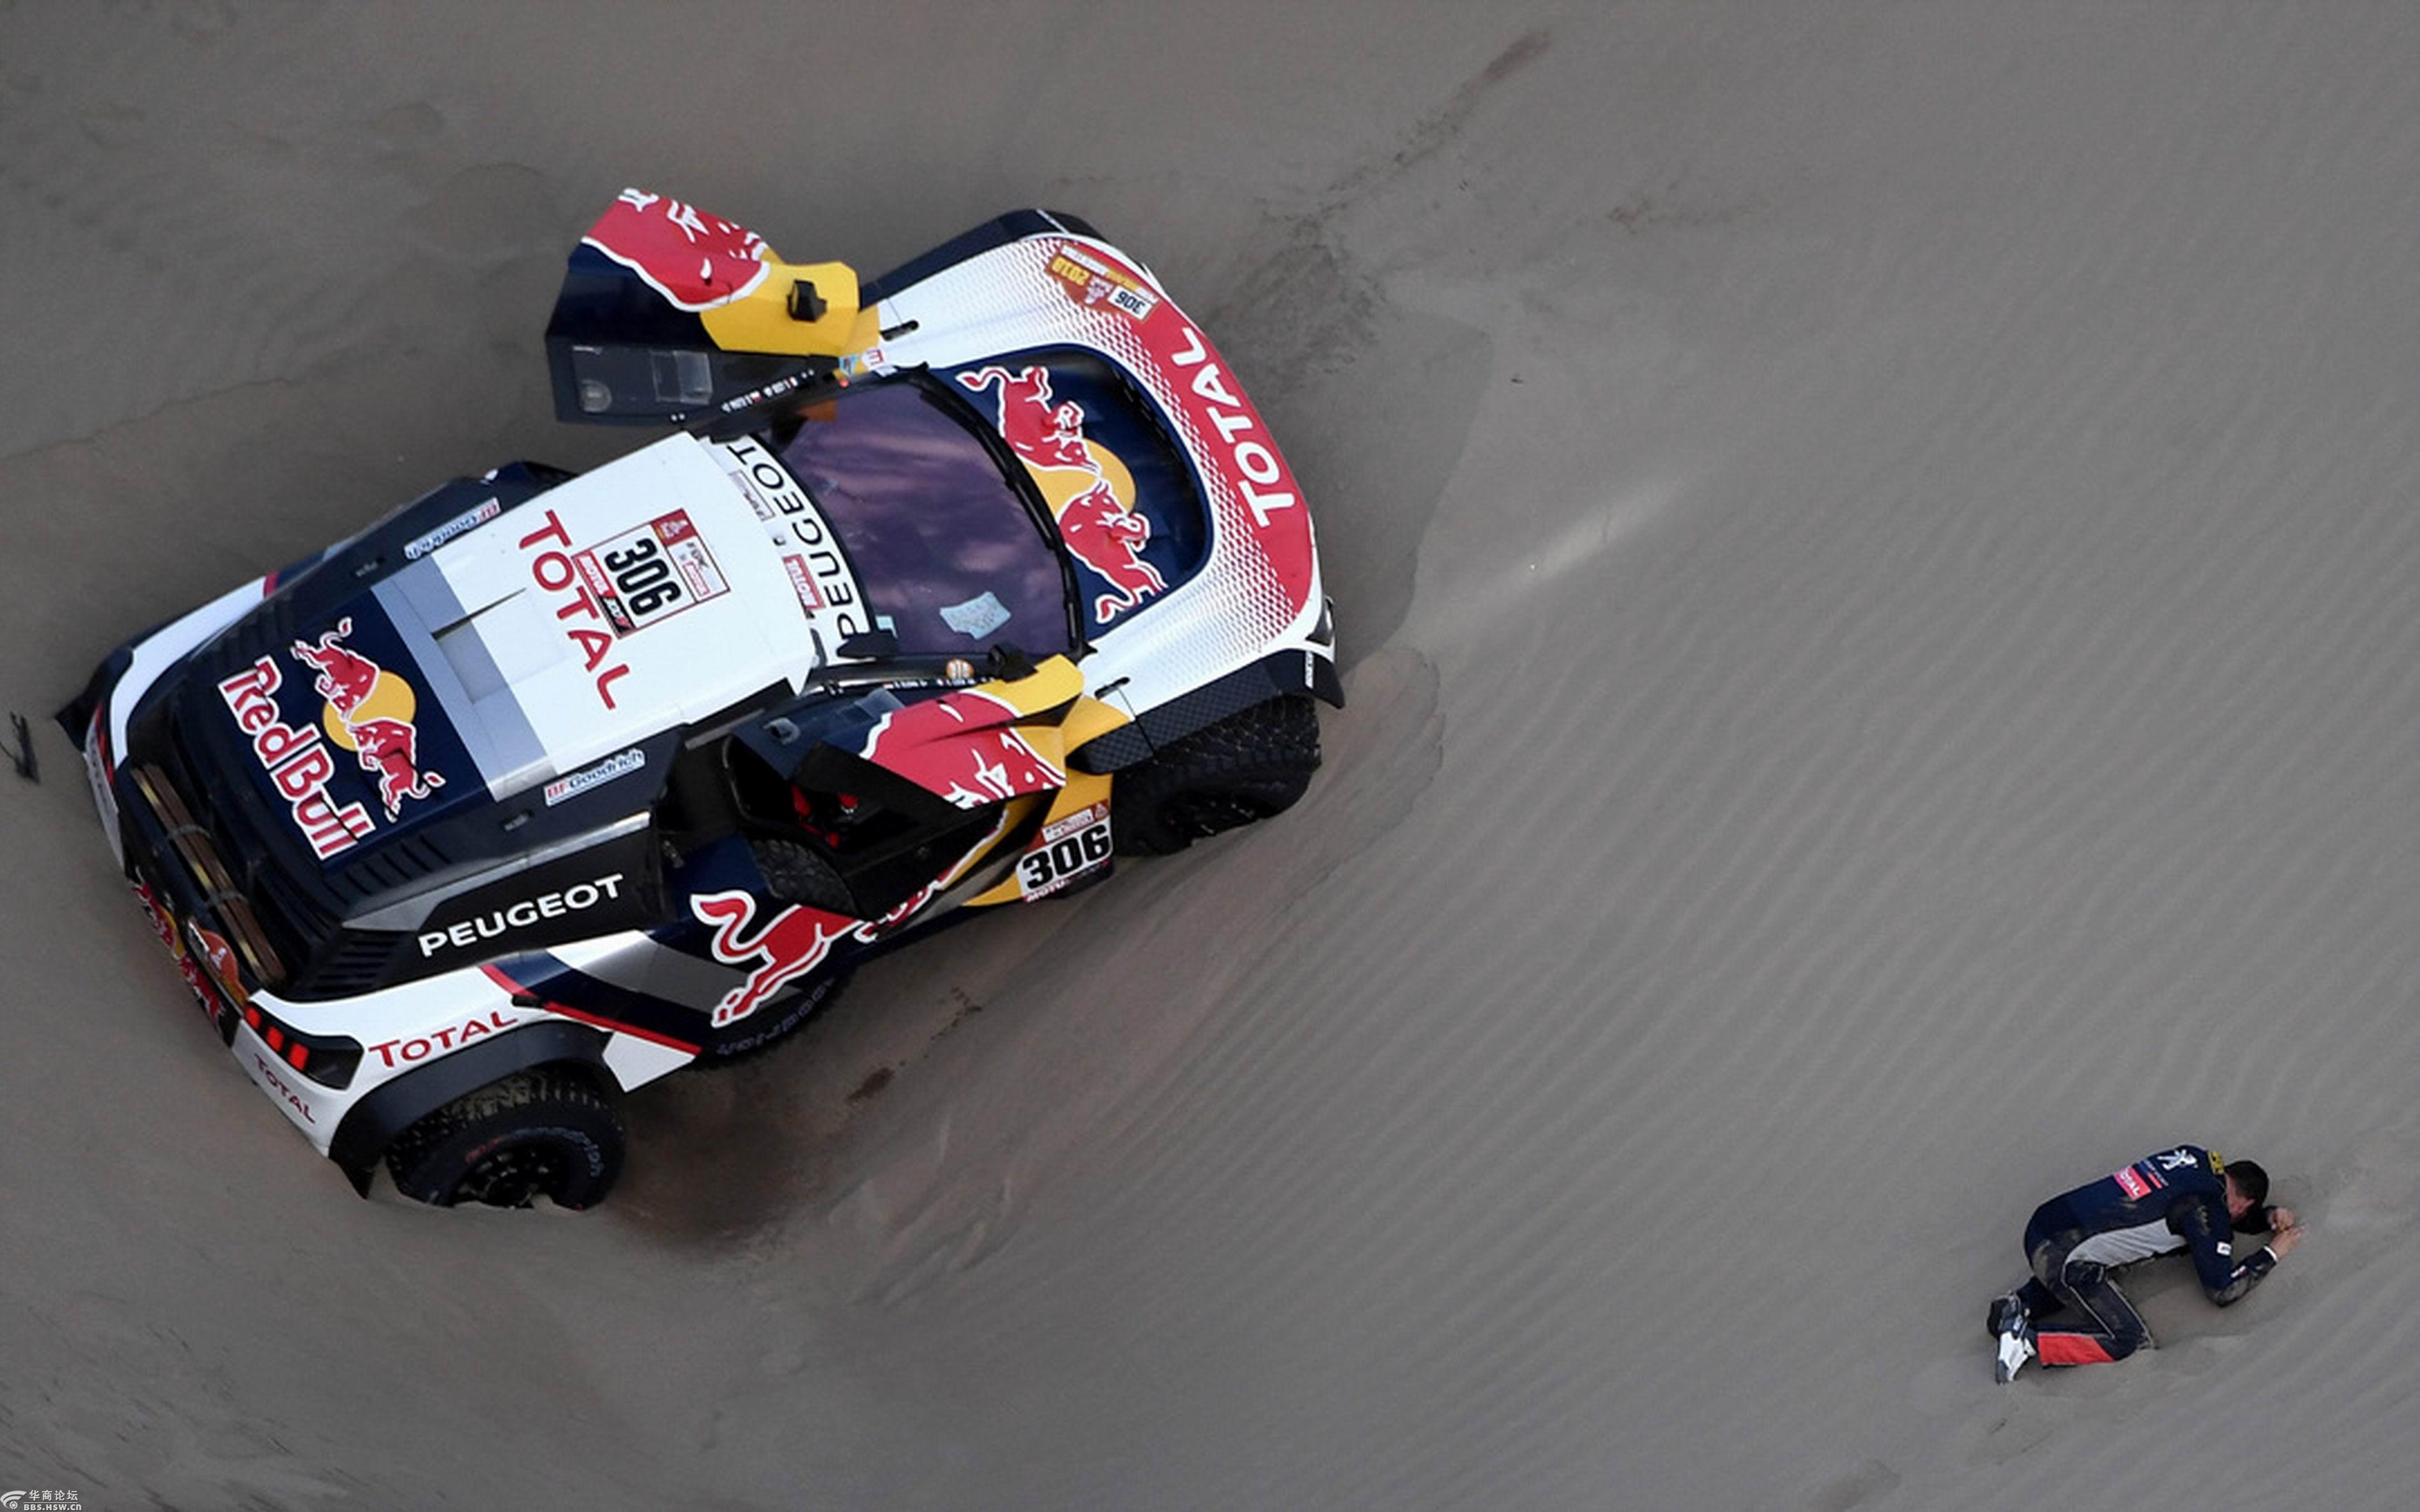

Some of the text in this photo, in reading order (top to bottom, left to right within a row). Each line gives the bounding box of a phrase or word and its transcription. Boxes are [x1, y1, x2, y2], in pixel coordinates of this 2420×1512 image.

[1115, 290, 1146, 315] 306
[1171, 327, 1295, 528] TOTAL
[578, 556, 610, 596] MOTUL
[604, 537, 682, 616] 306
[726, 444, 860, 640] PEUGEOT
[518, 509, 630, 710] TOTAL
[786, 559, 819, 607] MOTUL
[1021, 825, 1111, 889] 306
[418, 873, 623, 956] PEUGEOT
[368, 1011, 518, 1068] TOTAL
[254, 1052, 315, 1124] TOTAL
